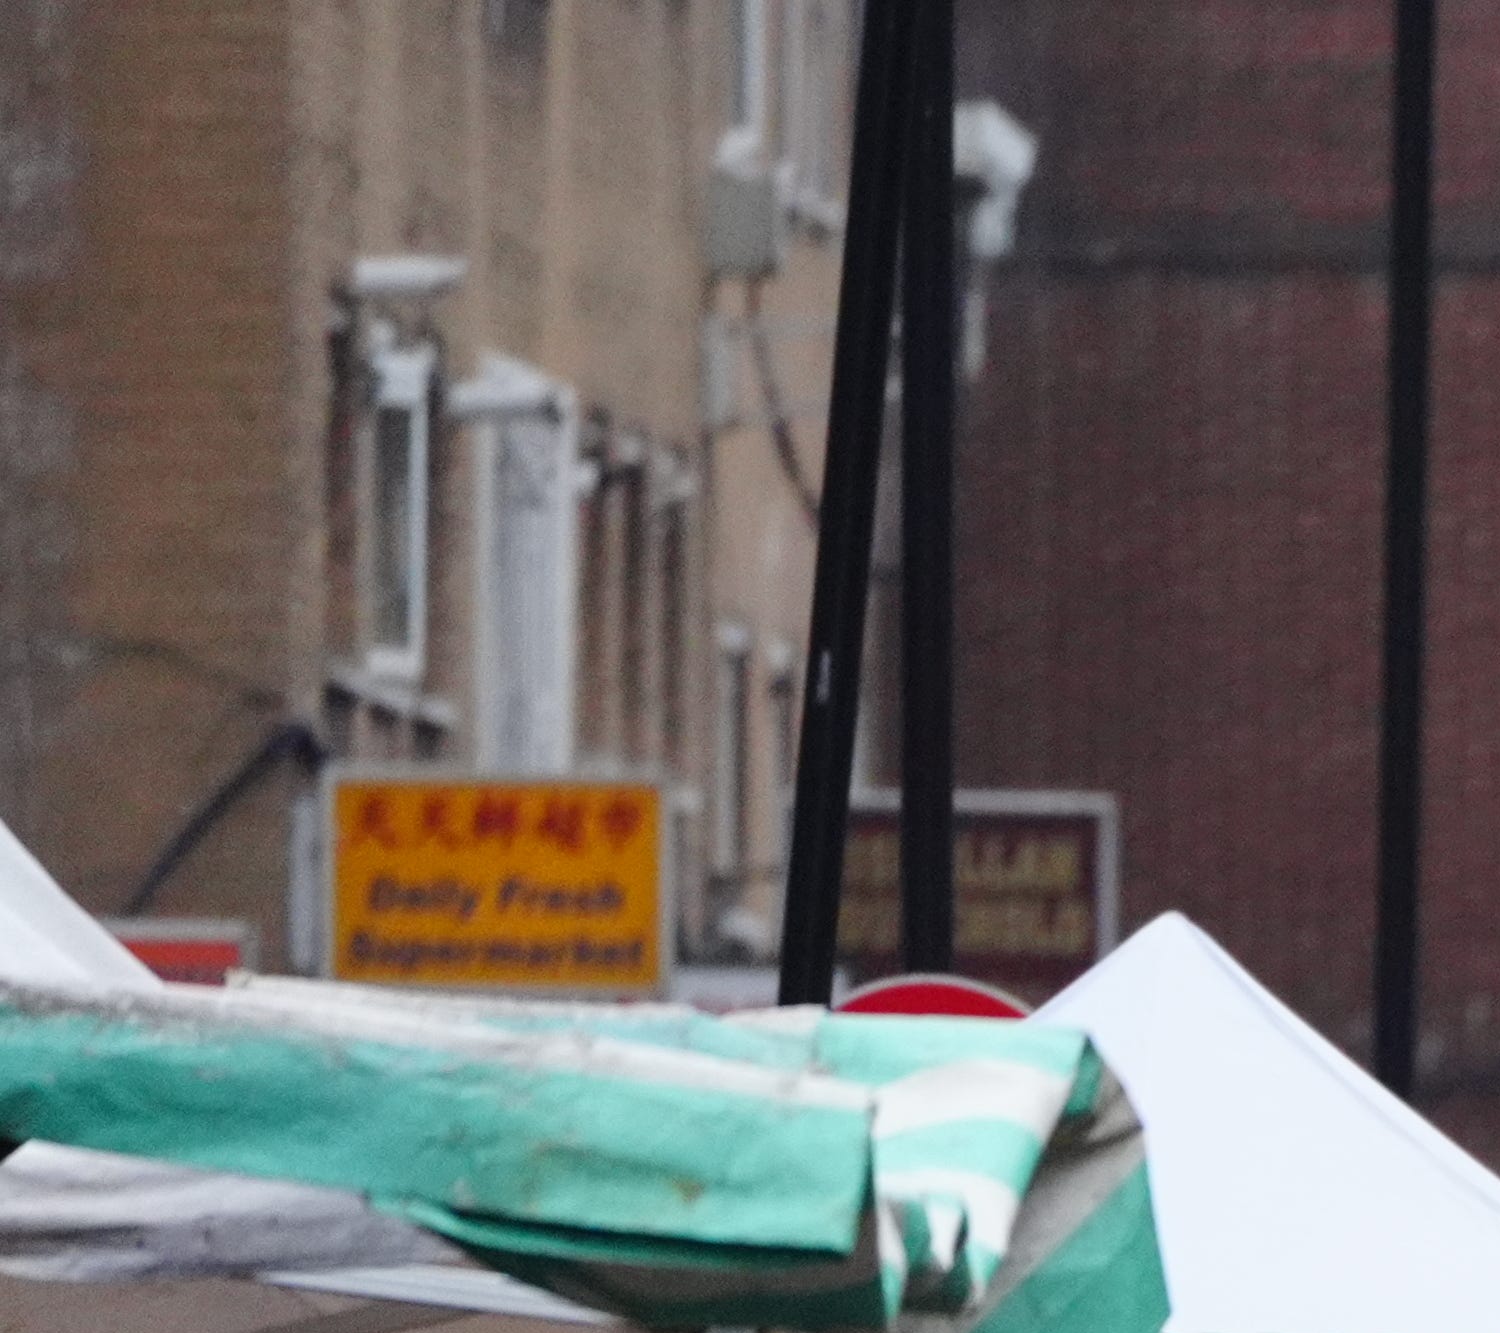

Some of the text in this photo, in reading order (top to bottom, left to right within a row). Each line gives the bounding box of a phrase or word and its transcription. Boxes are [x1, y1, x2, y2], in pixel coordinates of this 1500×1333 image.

[367, 876, 625, 922] Daily Fresh
[350, 931, 643, 971] Supermarket
